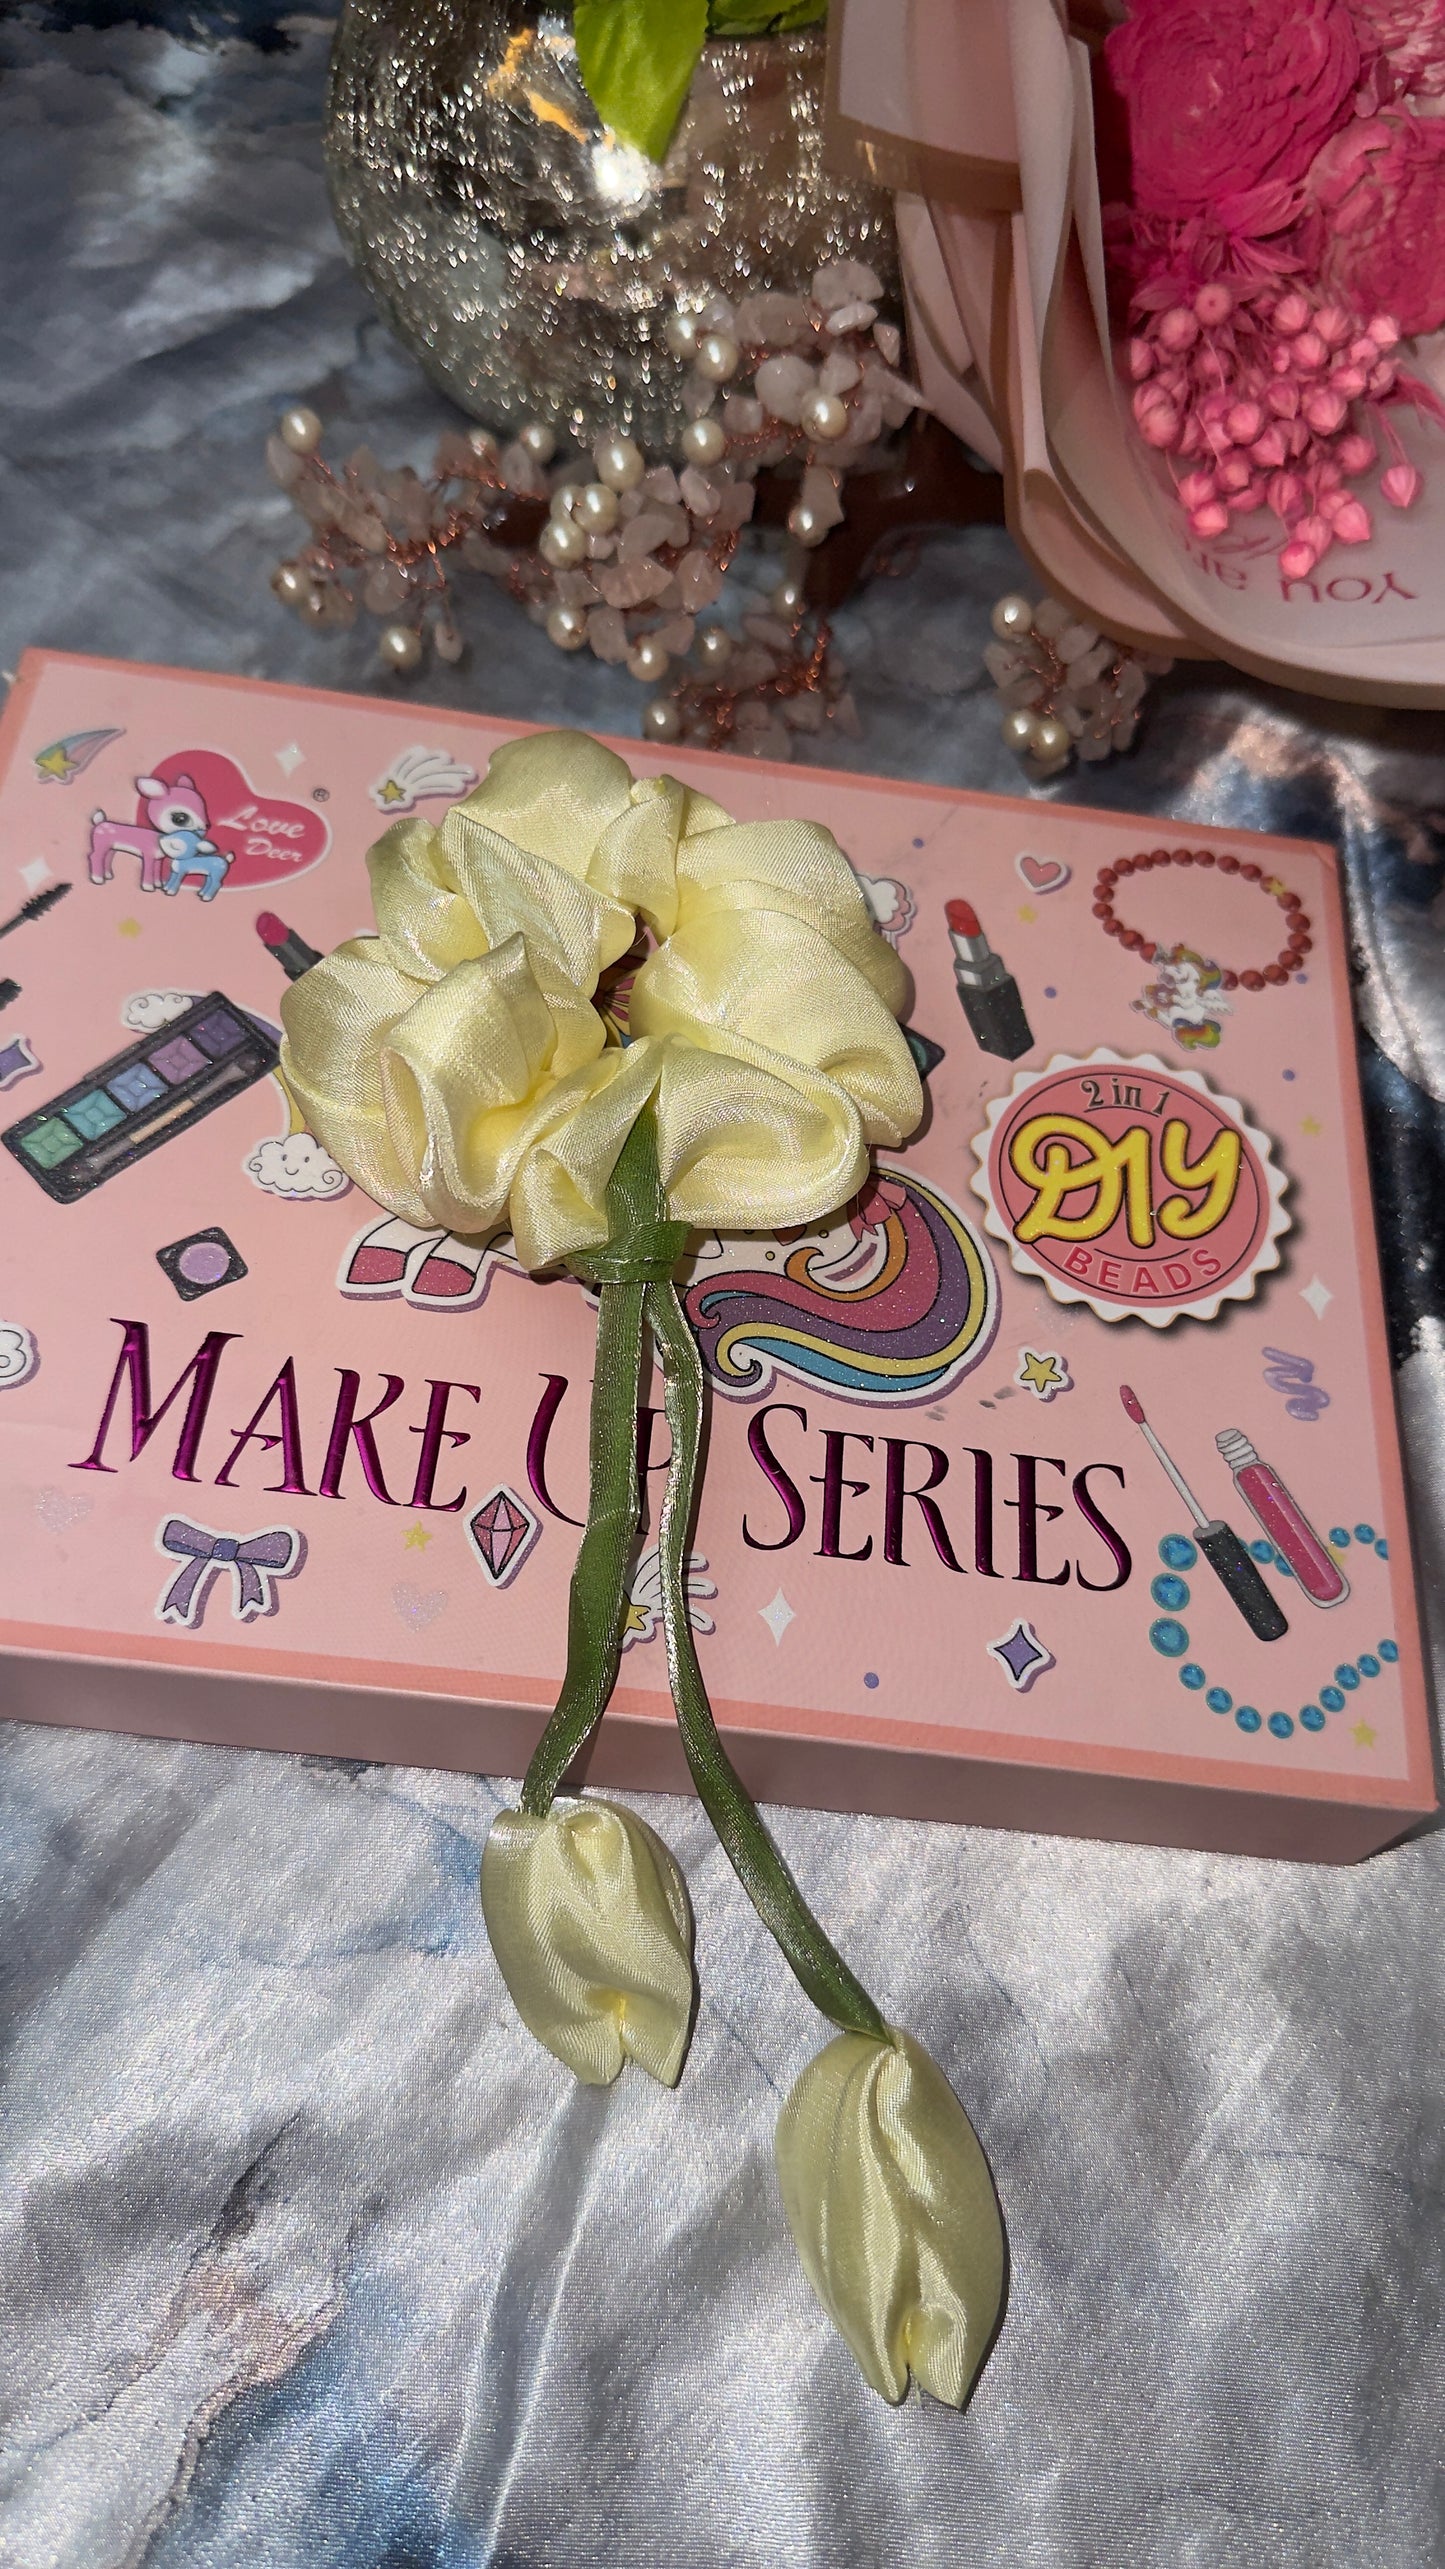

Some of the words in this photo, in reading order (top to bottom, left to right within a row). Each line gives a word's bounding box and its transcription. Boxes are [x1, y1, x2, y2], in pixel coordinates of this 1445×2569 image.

[217, 805, 305, 839] Love
[245, 837, 303, 863] Deer
[1080, 1079, 1104, 1108] 2
[1111, 1078, 1142, 1108] in
[1154, 1090, 1170, 1116] 1
[1008, 1112, 1242, 1249] DIY
[1063, 1246, 1222, 1294] BEADS
[67, 1317, 481, 1513] MAKE
[742, 1403, 1132, 1592] SERIES
